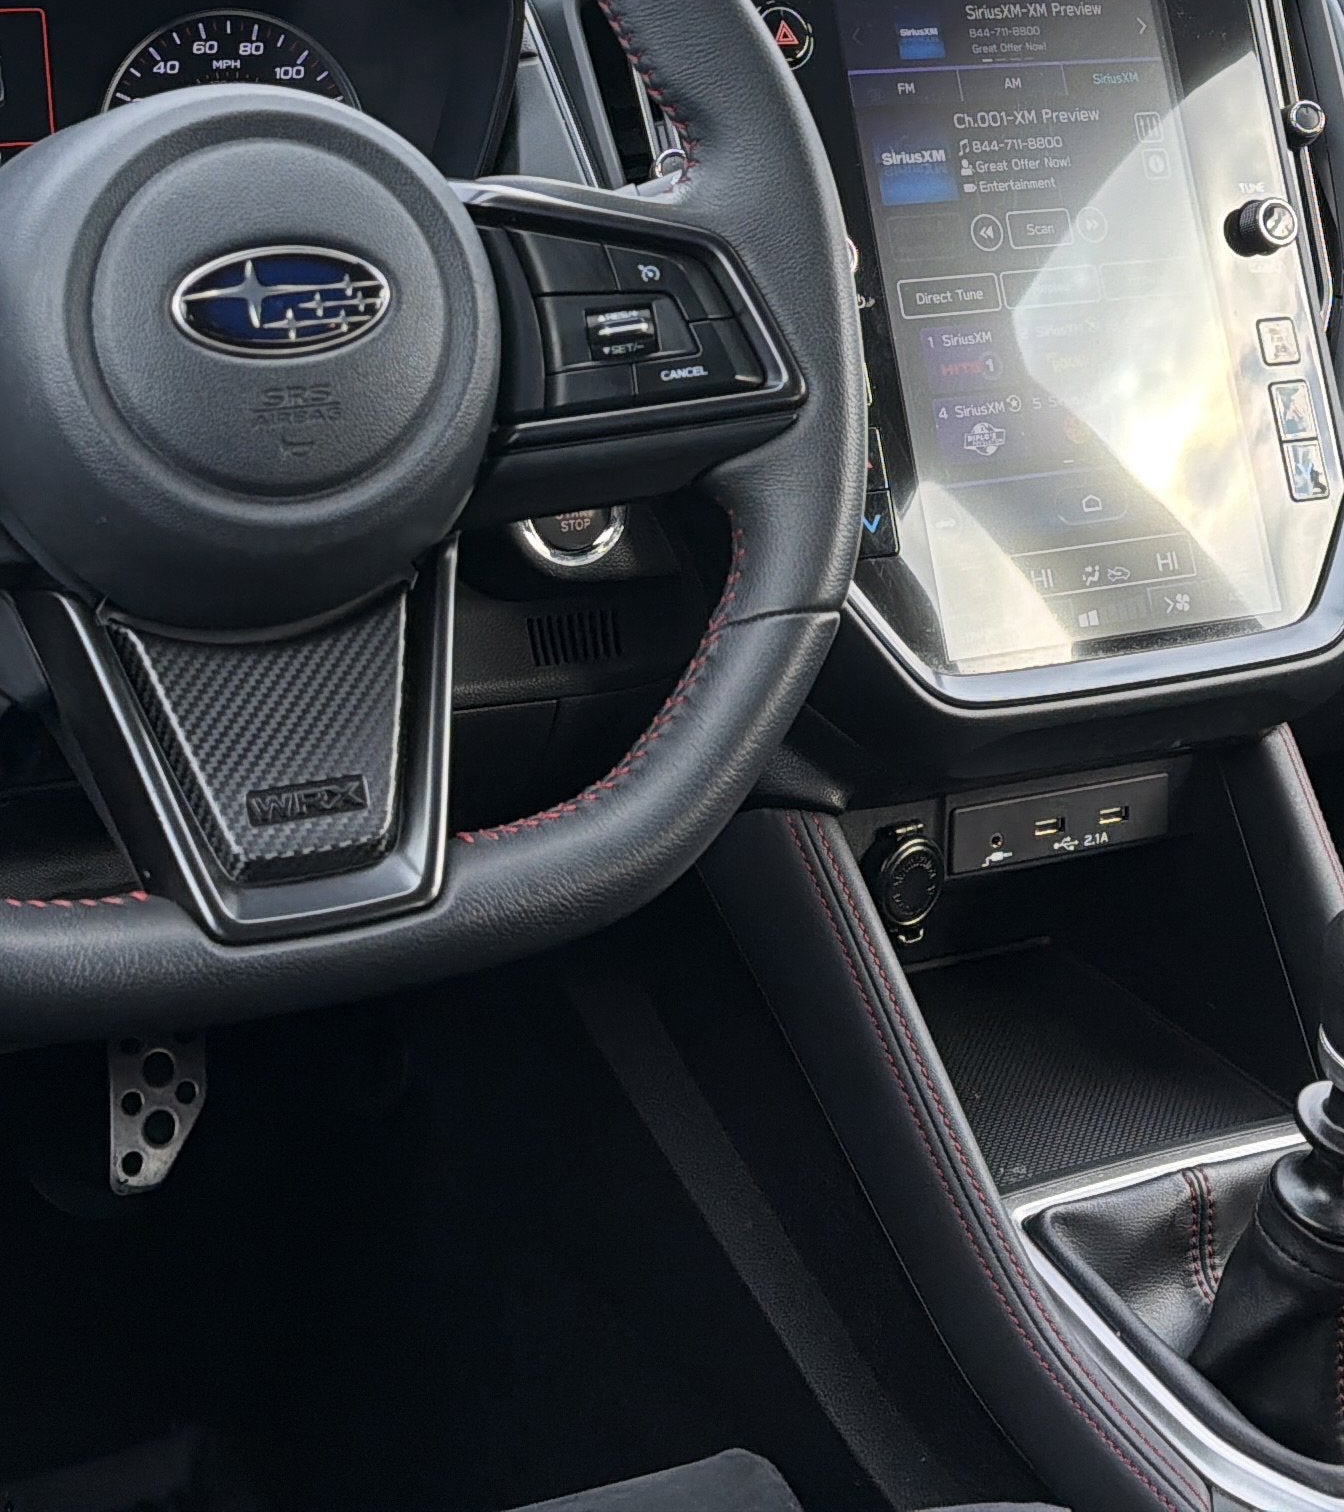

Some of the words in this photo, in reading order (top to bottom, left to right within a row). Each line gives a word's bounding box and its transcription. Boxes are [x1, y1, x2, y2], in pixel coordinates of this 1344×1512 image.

[965, 2, 1047, 21] SiriusXM-XM
[1051, 1, 1102, 18] Preview
[899, 26, 939, 37] SiriusXM
[969, 25, 1041, 39] 844-711-8800
[192, 40, 218, 54] 60
[238, 41, 264, 56] 80
[972, 43, 998, 55] Great
[1000, 42, 1023, 54] Offer
[1025, 40, 1048, 52] Now!
[152, 60, 180, 75] 40
[212, 59, 241, 70] MPH
[274, 65, 305, 80] 100
[1004, 77, 1022, 90] AM
[1092, 71, 1140, 85] SiriusXM
[897, 82, 916, 95] FM
[953, 108, 1037, 129] Ch.001-XM
[1041, 107, 1100, 124] Preview
[972, 135, 1063, 153] 844-711-8800
[881, 149, 947, 166] SiriusXM
[976, 159, 1009, 173] Great
[1011, 157, 1041, 171] Offer
[1044, 155, 1072, 169] Now!
[979, 176, 1056, 193] Entertainment
[1026, 222, 1056, 236] Scan
[915, 288, 953, 305] Direct
[955, 287, 984, 303] Tune
[927, 336, 936, 349] 1
[941, 330, 993, 348] SiriusXM
[659, 365, 709, 382] CANCEL
[938, 407, 948, 420] 4
[954, 400, 1006, 418] SiriusXM
[560, 518, 591, 533] STOP
[1156, 551, 1179, 572] HI
[252, 779, 362, 821] WRX
[1083, 831, 1110, 848] 2.1A
